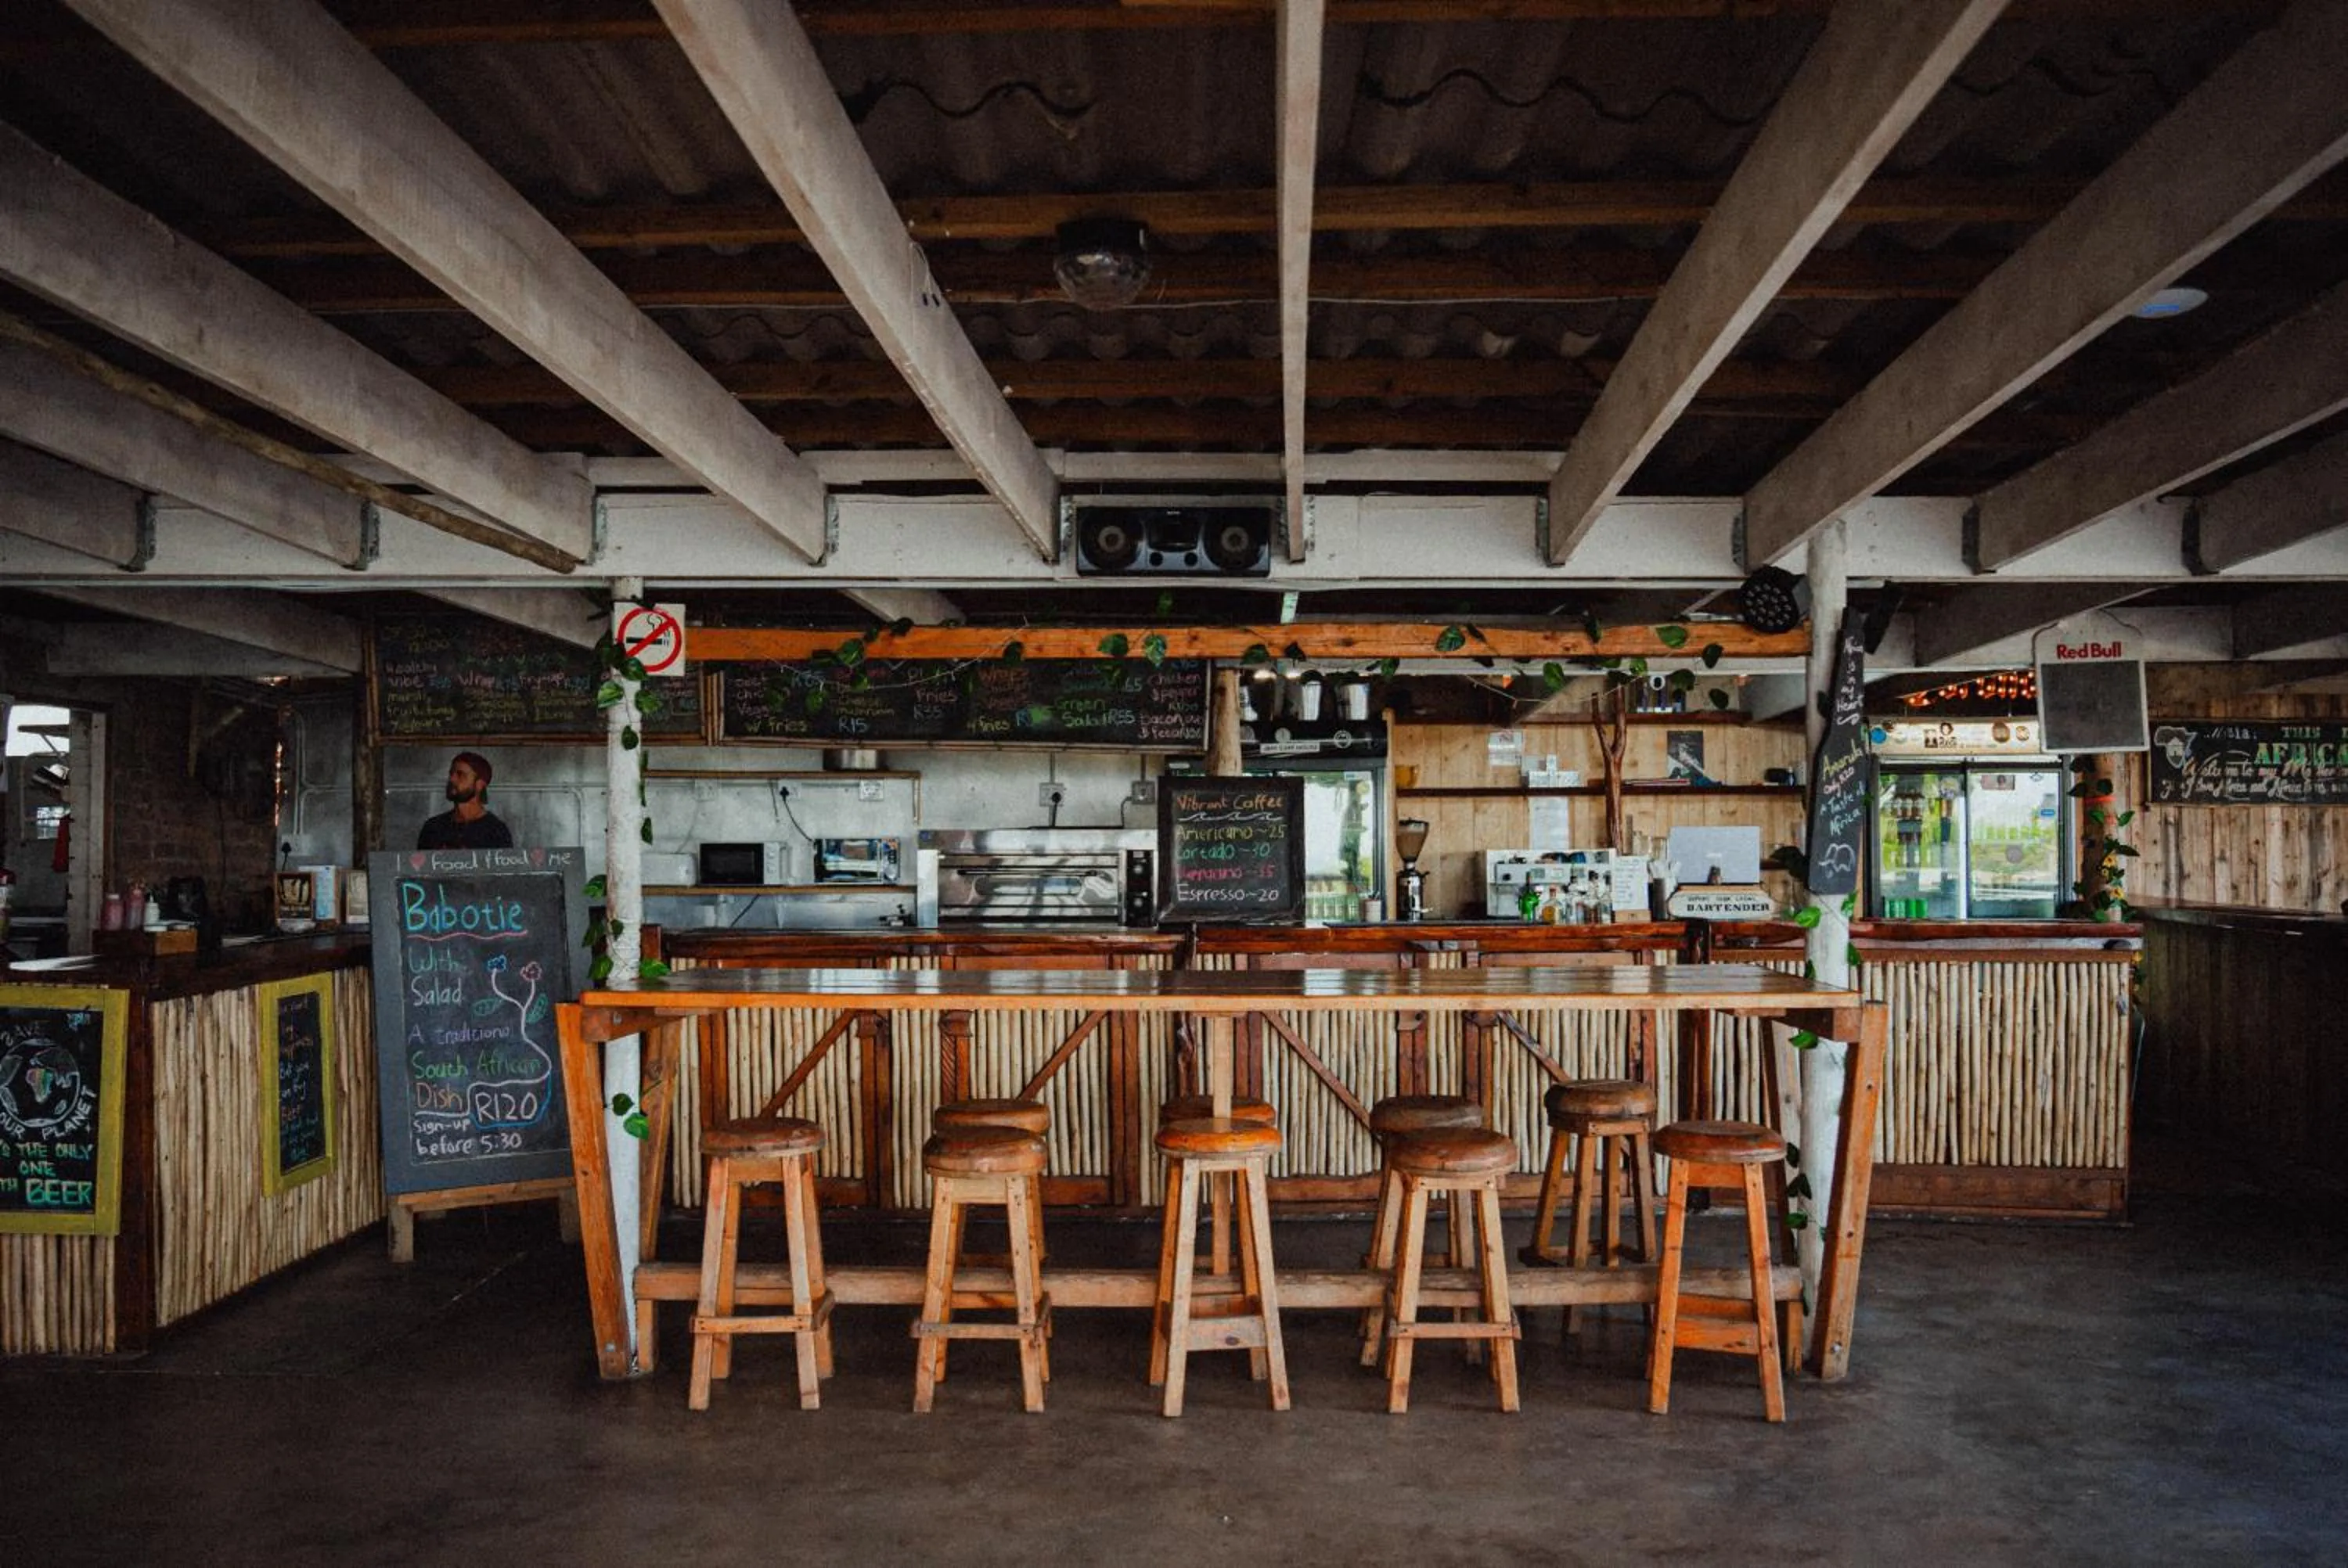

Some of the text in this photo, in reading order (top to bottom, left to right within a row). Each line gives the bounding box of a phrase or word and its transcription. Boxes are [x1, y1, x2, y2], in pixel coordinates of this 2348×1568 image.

[2057, 640, 2122, 659] Red Bull
[403, 882, 524, 933] Babotie
[1687, 904, 1770, 912] BARTENDER
[410, 975, 463, 1007] Salad
[408, 1023, 424, 1045] A
[412, 1048, 542, 1080] South African
[41, 1084, 98, 1140] PLANET
[416, 1081, 538, 1124] Dish R120
[17, 1142, 49, 1158] THE
[56, 1142, 95, 1160] ONLY
[416, 1134, 474, 1156] before
[20, 1160, 57, 1178] ONE
[26, 1178, 95, 1207] BEER
